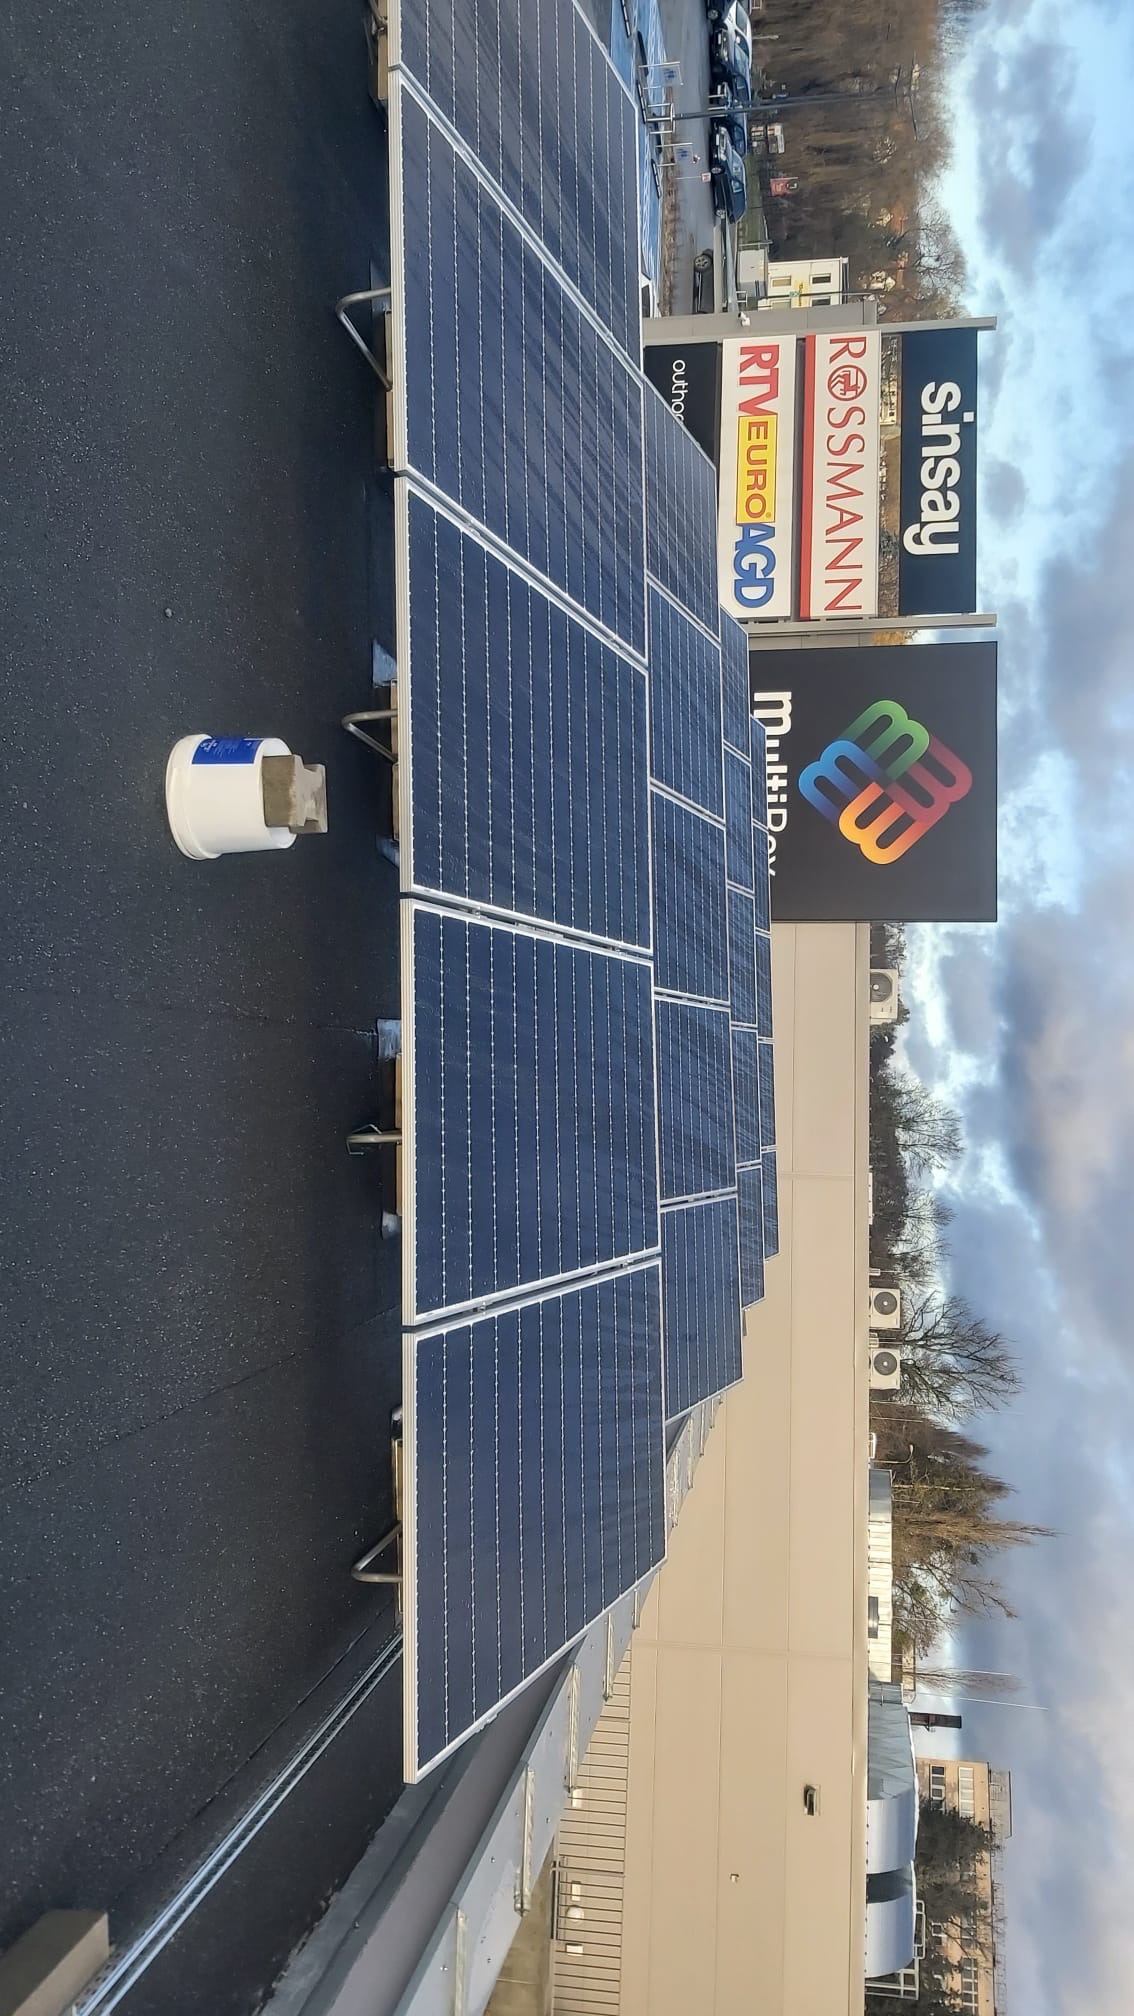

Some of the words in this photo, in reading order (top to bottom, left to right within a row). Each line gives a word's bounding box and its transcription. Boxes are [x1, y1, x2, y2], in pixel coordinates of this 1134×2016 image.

[738, 344, 779, 416] RTV
[824, 336, 867, 611] ROSSMANN
[903, 382, 974, 555] sinsay
[734, 523, 776, 608] AGD
